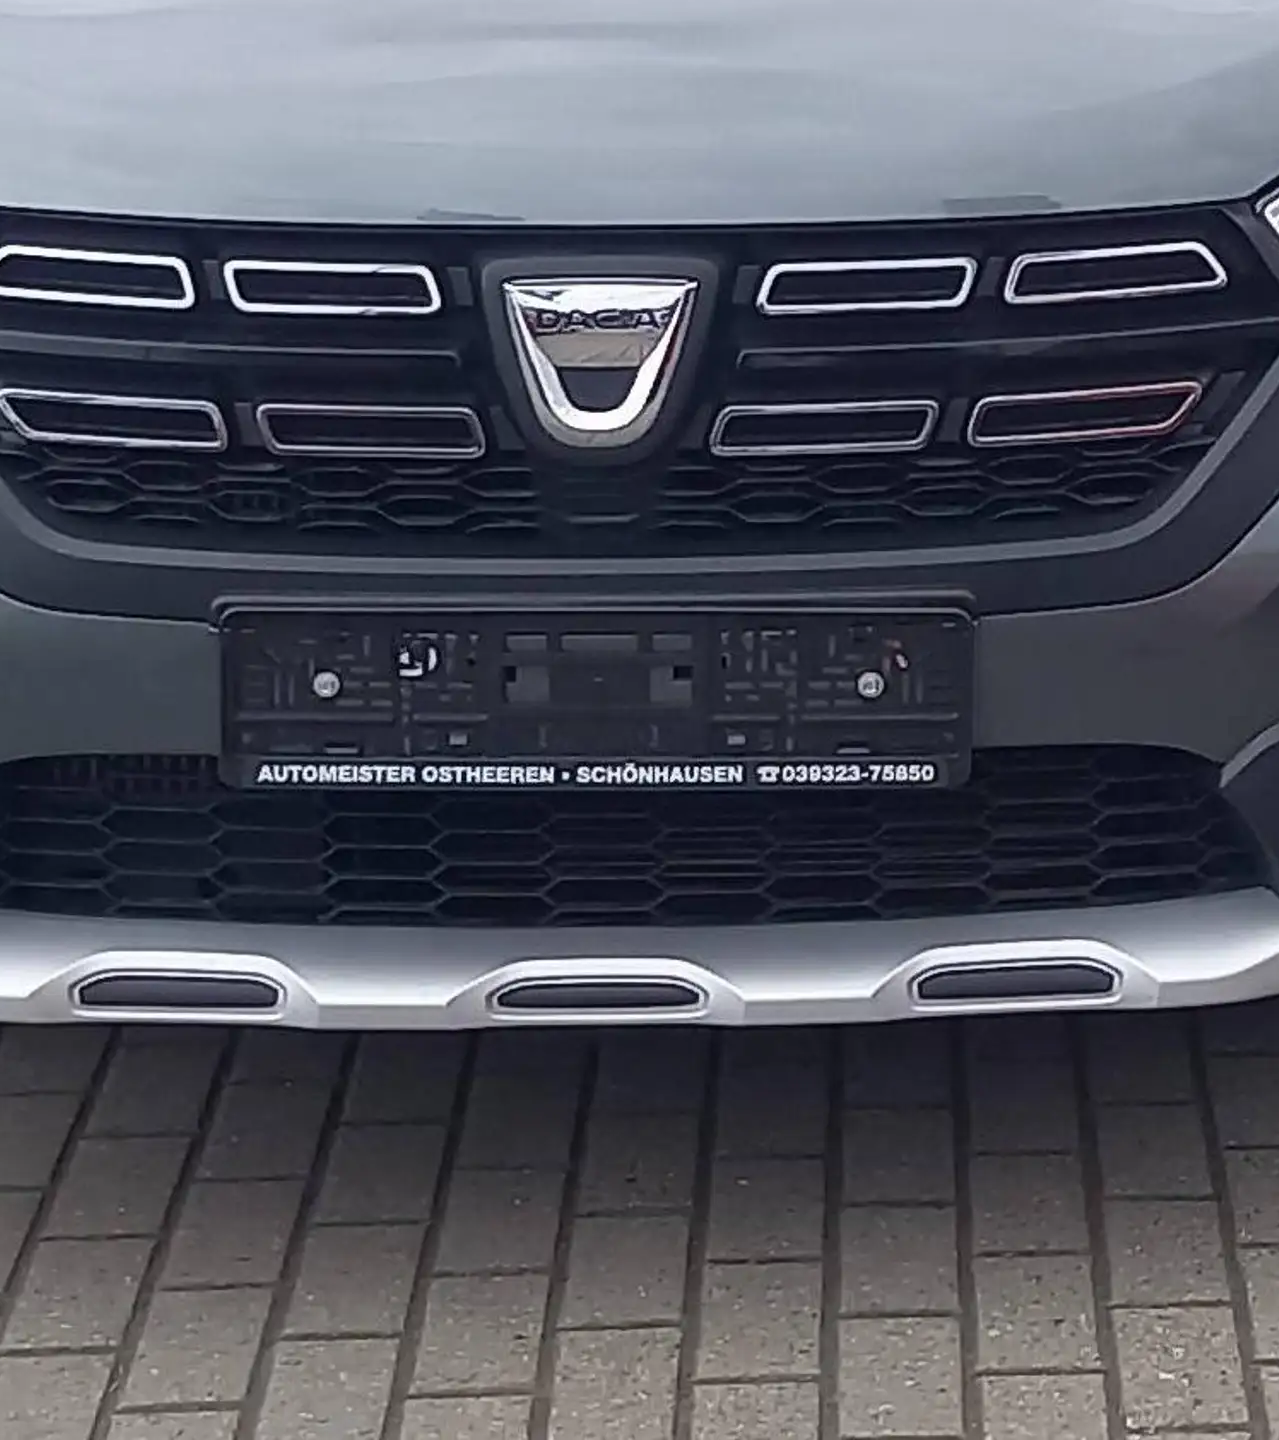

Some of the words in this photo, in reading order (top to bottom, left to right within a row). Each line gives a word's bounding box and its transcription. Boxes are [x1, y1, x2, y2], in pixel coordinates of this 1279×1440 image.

[256, 763, 416, 784] AUTOMEISTER
[420, 764, 554, 784] OSTHEEREN
[575, 762, 743, 783] SCHÖNHAUSEN
